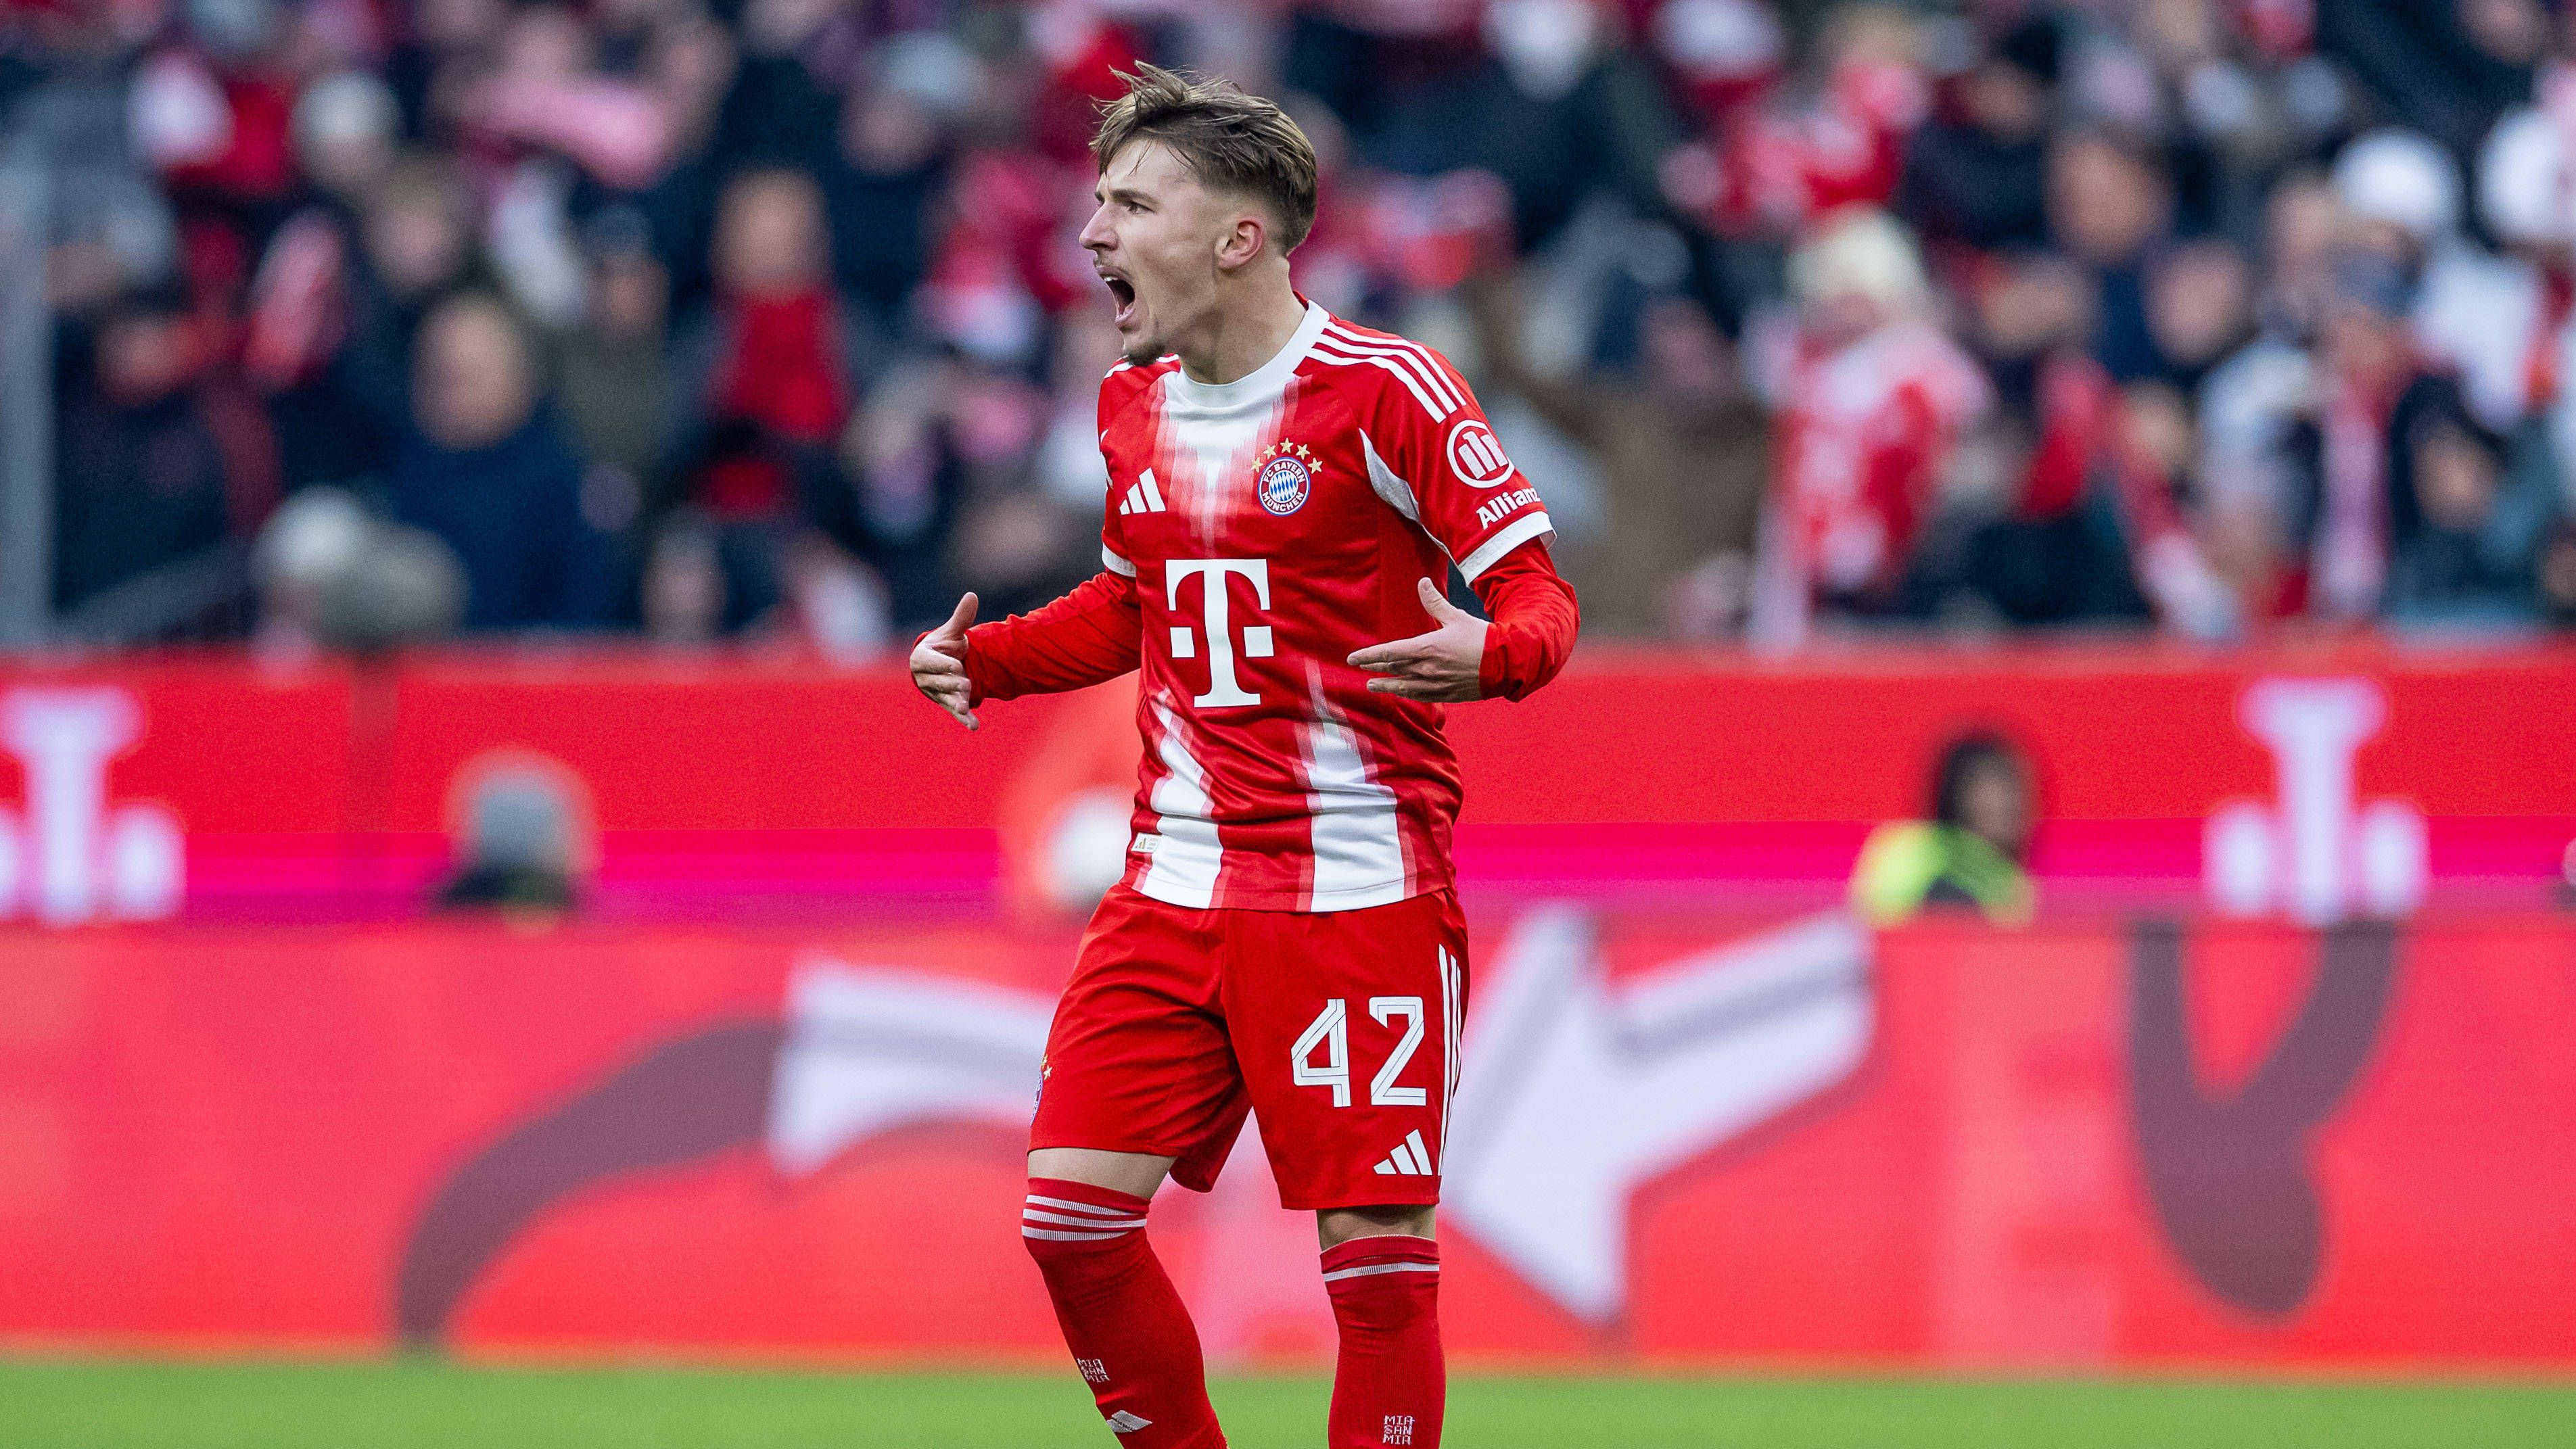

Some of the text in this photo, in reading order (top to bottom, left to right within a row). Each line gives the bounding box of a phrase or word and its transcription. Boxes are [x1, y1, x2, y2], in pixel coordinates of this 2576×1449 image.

[1263, 462, 1305, 483] FC BAYERN
[1476, 488, 1541, 530] Allianz
[1165, 559, 1274, 708] T
[1291, 996, 1426, 1108] 42
[1384, 1415, 1415, 1425] MIA
[1384, 1425, 1412, 1435] SAN
[1382, 1433, 1411, 1445] MIA
